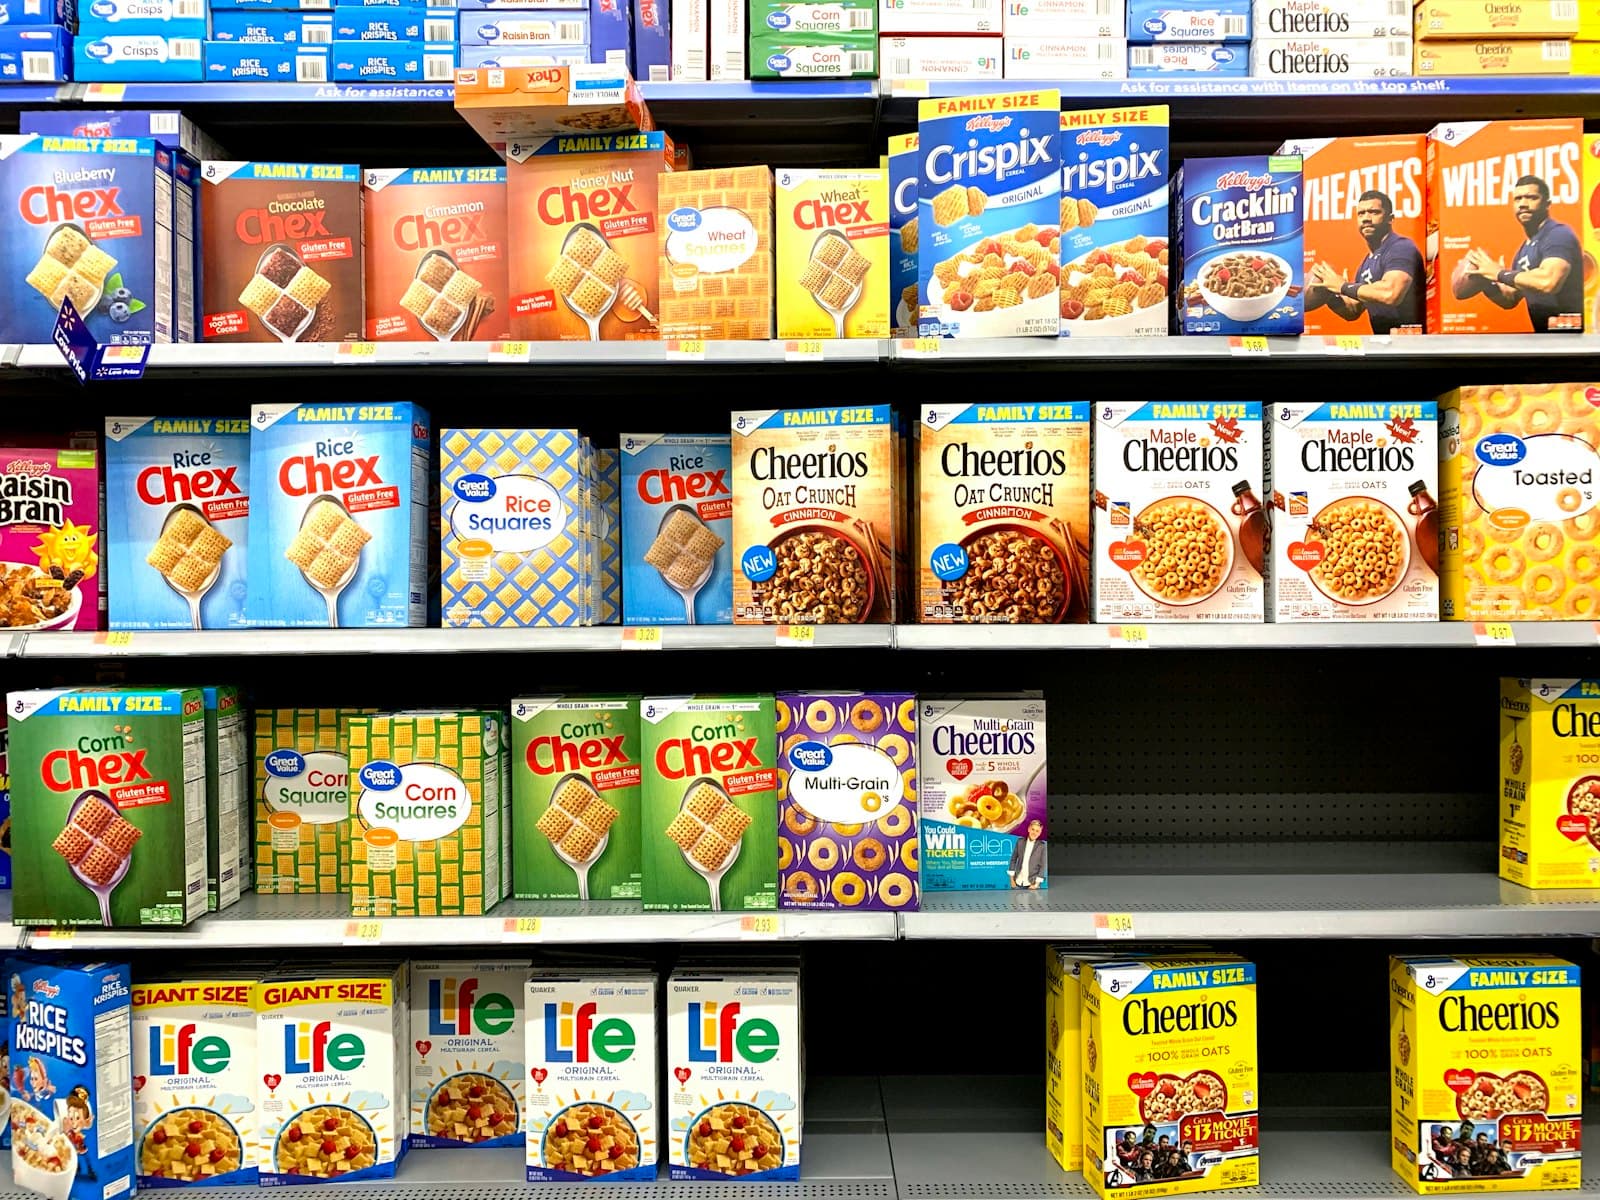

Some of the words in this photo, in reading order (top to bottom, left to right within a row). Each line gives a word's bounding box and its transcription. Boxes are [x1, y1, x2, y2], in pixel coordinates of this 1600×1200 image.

[812, 11, 840, 20] Corn
[1190, 16, 1215, 27] Rice
[1269, 7, 1349, 34] Cheerios
[502, 31, 527, 40] Raisin
[529, 31, 550, 40] Bran
[1287, 42, 1320, 54] Maple
[812, 53, 840, 63] Corn
[1269, 48, 1349, 74] Cheerios
[527, 69, 561, 83] Chex
[315, 87, 337, 97] Ask
[340, 87, 364, 97] for
[368, 87, 436, 97] assistance
[1121, 82, 1150, 93] Ask
[1154, 82, 1172, 93] for
[1175, 82, 1248, 94] assistance
[1252, 81, 1284, 92] with
[1331, 83, 1350, 92] on
[1353, 80, 1377, 91] the
[1381, 82, 1406, 94] top
[1410, 80, 1450, 91] shelf.
[938, 98, 996, 113] FAMILY
[1002, 94, 1039, 109] SIZE
[1060, 112, 1104, 127] AMILY
[1112, 110, 1149, 123] SIZE
[42, 139, 98, 152] FAMILY
[103, 139, 137, 153] SIZE
[559, 137, 612, 152] FAMILY
[616, 135, 648, 149] SIZE
[925, 127, 1054, 184] Crispix
[53, 167, 115, 185] Blueberry
[254, 165, 307, 178] FAMILY
[311, 165, 342, 178] SIZE
[413, 170, 464, 183] FAMILY
[468, 169, 497, 182] SIZE
[1061, 142, 1163, 194] rispix
[1443, 142, 1580, 207] WHEATIES
[820, 188, 861, 204] Wheat
[1001, 186, 1044, 205] ORIGINAL
[20, 186, 125, 225] Chex
[268, 199, 325, 214] Chocolate
[424, 201, 484, 219] Cinnamon
[538, 185, 639, 226] Chex
[1112, 200, 1152, 217] ORIGINAL
[1192, 187, 1297, 225] Cracklin'
[793, 199, 873, 231] Chex
[236, 208, 331, 245] Chex
[393, 213, 487, 251] Chex
[1213, 223, 1240, 240] Oat
[1241, 221, 1275, 236] Bran
[708, 230, 746, 242] Wheat
[54, 328, 69, 352] Low
[68, 350, 86, 380] Price
[804, 342, 820, 354] 3.28
[922, 341, 938, 352] 3.64
[297, 407, 355, 421] FAMILY
[358, 407, 394, 421] SIZE
[783, 411, 839, 426] FAMILY
[841, 409, 873, 423] SIZE
[978, 407, 1036, 422] FAMILY
[1039, 405, 1072, 420] SIZE
[153, 419, 210, 433] FAMILY
[215, 419, 249, 433] SIZE
[1150, 428, 1196, 445] Maple
[1328, 429, 1372, 445] Maple
[316, 439, 353, 458] Rice
[1123, 438, 1238, 472] Cheerios
[1302, 438, 1415, 472] Cheerios
[1483, 442, 1518, 454] Great
[173, 450, 211, 469] Rice
[670, 455, 703, 472] Rice
[751, 443, 869, 480] Cheerios
[941, 441, 1066, 477] Cheerios
[279, 455, 383, 496] Chex
[1515, 468, 1591, 486] Toasted
[136, 464, 241, 505] Chex
[458, 480, 488, 492] Great
[637, 468, 731, 505] Chex
[1184, 481, 1211, 489] OATS
[1362, 481, 1387, 489] OATS
[506, 496, 551, 513] Rice
[784, 509, 836, 521] CINNAMON
[976, 508, 1032, 520] CINNAMON
[469, 514, 551, 534] Squares
[743, 556, 773, 575] NEW
[934, 554, 965, 574] NEW
[794, 628, 810, 638] 3.64
[60, 697, 121, 712] FAMILY
[125, 697, 163, 711] SIZE
[560, 722, 604, 740] Corn
[691, 722, 736, 742] Corn
[79, 735, 124, 754] Corn
[933, 726, 1035, 756] Cheerios
[525, 735, 630, 776] Chex
[655, 737, 762, 780] Chex
[42, 749, 152, 792] Chex
[988, 762, 995, 772] 5
[405, 784, 456, 801] Corn
[805, 777, 889, 791] Multi-Grain
[1505, 781, 1526, 790] WHOLE
[1504, 789, 1526, 800] GRAIN
[375, 802, 457, 822] Squares
[924, 826, 938, 835] You
[939, 827, 956, 835] Could
[926, 849, 965, 858] TICKETS
[970, 837, 1012, 855] ellen
[520, 919, 536, 930] 3.28
[755, 919, 771, 932] 2.93
[1115, 918, 1131, 930] 3.64
[1153, 971, 1211, 990] FAMILY
[1212, 967, 1244, 983] SIZE
[1470, 971, 1528, 987] FAMILY
[1532, 970, 1567, 985] SIZE
[93, 988, 128, 1005] KRISPIES
[131, 988, 199, 1006] GIANT
[264, 985, 331, 1005] GIANT
[429, 978, 515, 1036] Life
[1439, 996, 1559, 1033] Cheerios
[29, 1002, 66, 1032] RICE
[1123, 996, 1238, 1036] Cheerios
[544, 1001, 636, 1063] Life
[688, 1001, 780, 1063] Life
[16, 1028, 86, 1064] KRISPIES
[149, 1023, 231, 1076] Life
[285, 1021, 365, 1074] Life
[447, 1039, 493, 1047] ORIGINAL
[1147, 1051, 1179, 1062] 100%
[1201, 1045, 1231, 1057] OATS
[1465, 1049, 1498, 1059] 100%
[1521, 1047, 1552, 1057] OATS
[564, 1067, 613, 1075] ORIGINAL
[708, 1066, 757, 1075] ORIGINAL
